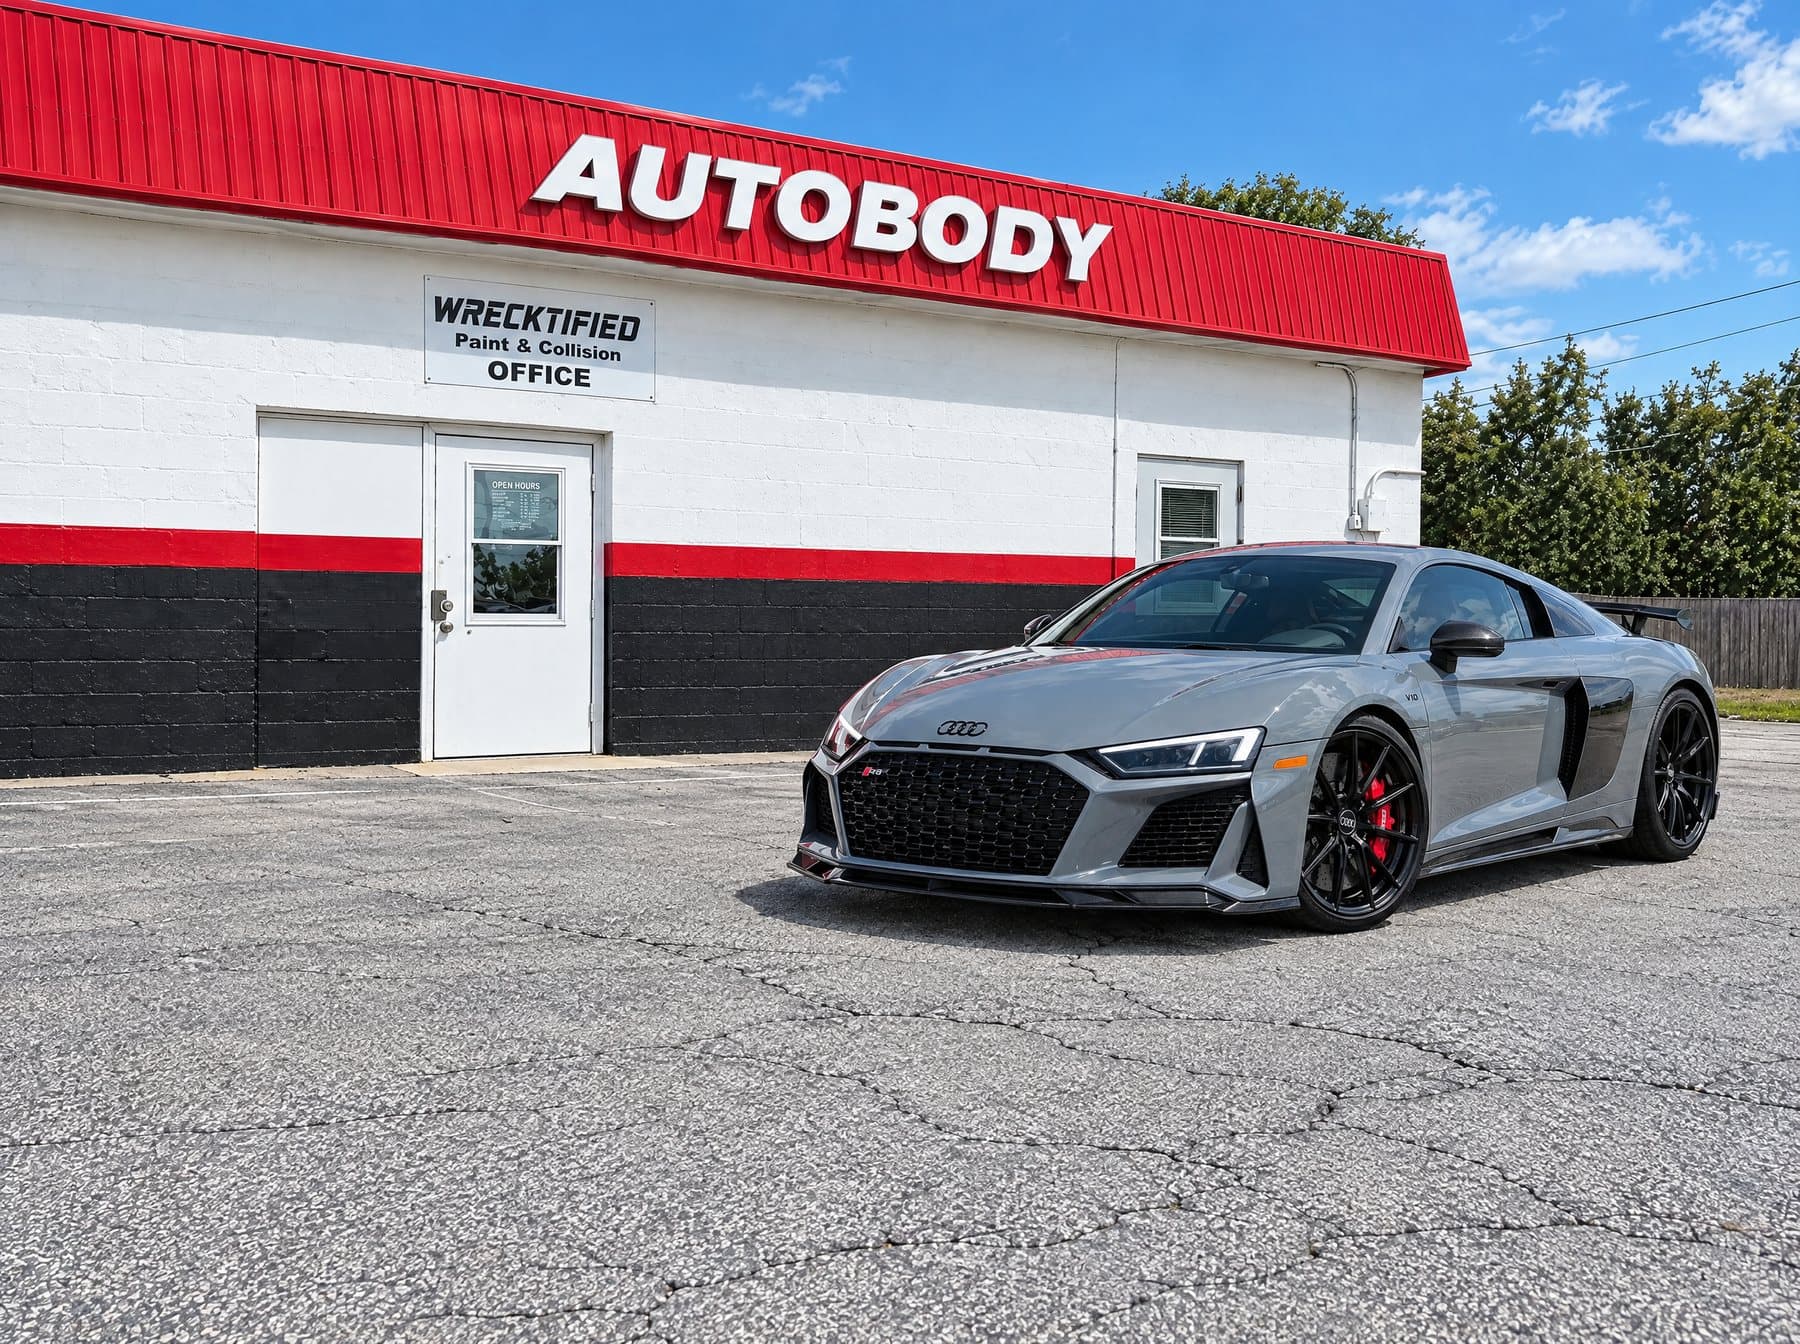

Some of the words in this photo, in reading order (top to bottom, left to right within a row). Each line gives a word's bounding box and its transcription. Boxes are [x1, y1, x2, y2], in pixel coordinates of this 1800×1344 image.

[530, 133, 1113, 283] AUTOBODY
[434, 295, 641, 342] WRECKTIFIED
[455, 332, 509, 352] Paint
[516, 338, 532, 353] &
[538, 340, 621, 362] Collision
[487, 360, 591, 388] OFFICE
[492, 481, 513, 489] OPEN
[514, 481, 540, 490] HOURS
[1405, 693, 1419, 701] V10
